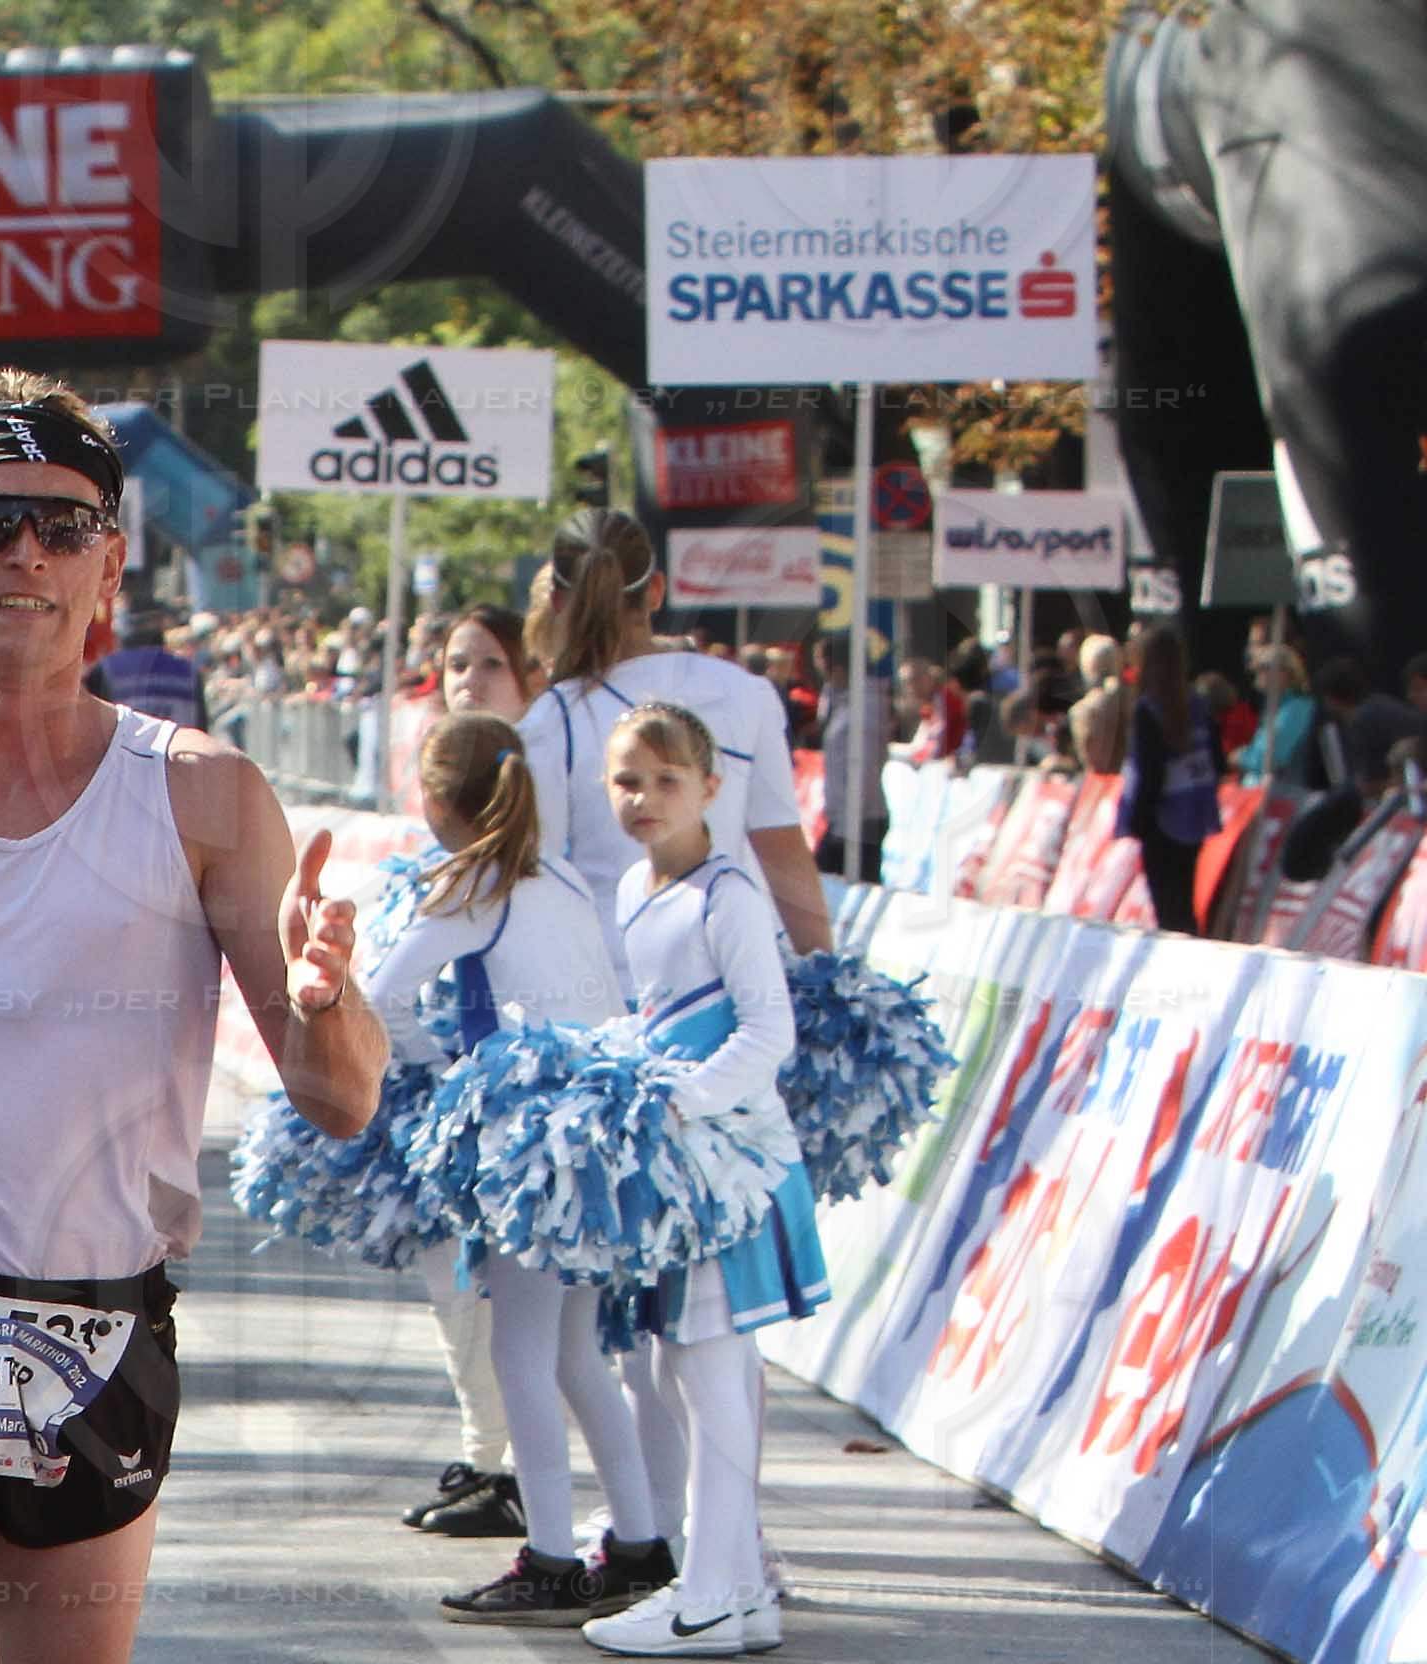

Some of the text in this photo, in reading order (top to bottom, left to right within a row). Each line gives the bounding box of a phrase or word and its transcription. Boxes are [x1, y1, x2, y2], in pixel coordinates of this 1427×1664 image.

[667, 221, 1009, 259] Steiermärkische
[667, 271, 1009, 322] SPARKASSE
[309, 440, 500, 488] adidas
[17, 1328, 73, 1369] MARATHON
[113, 1467, 153, 1489] erima
